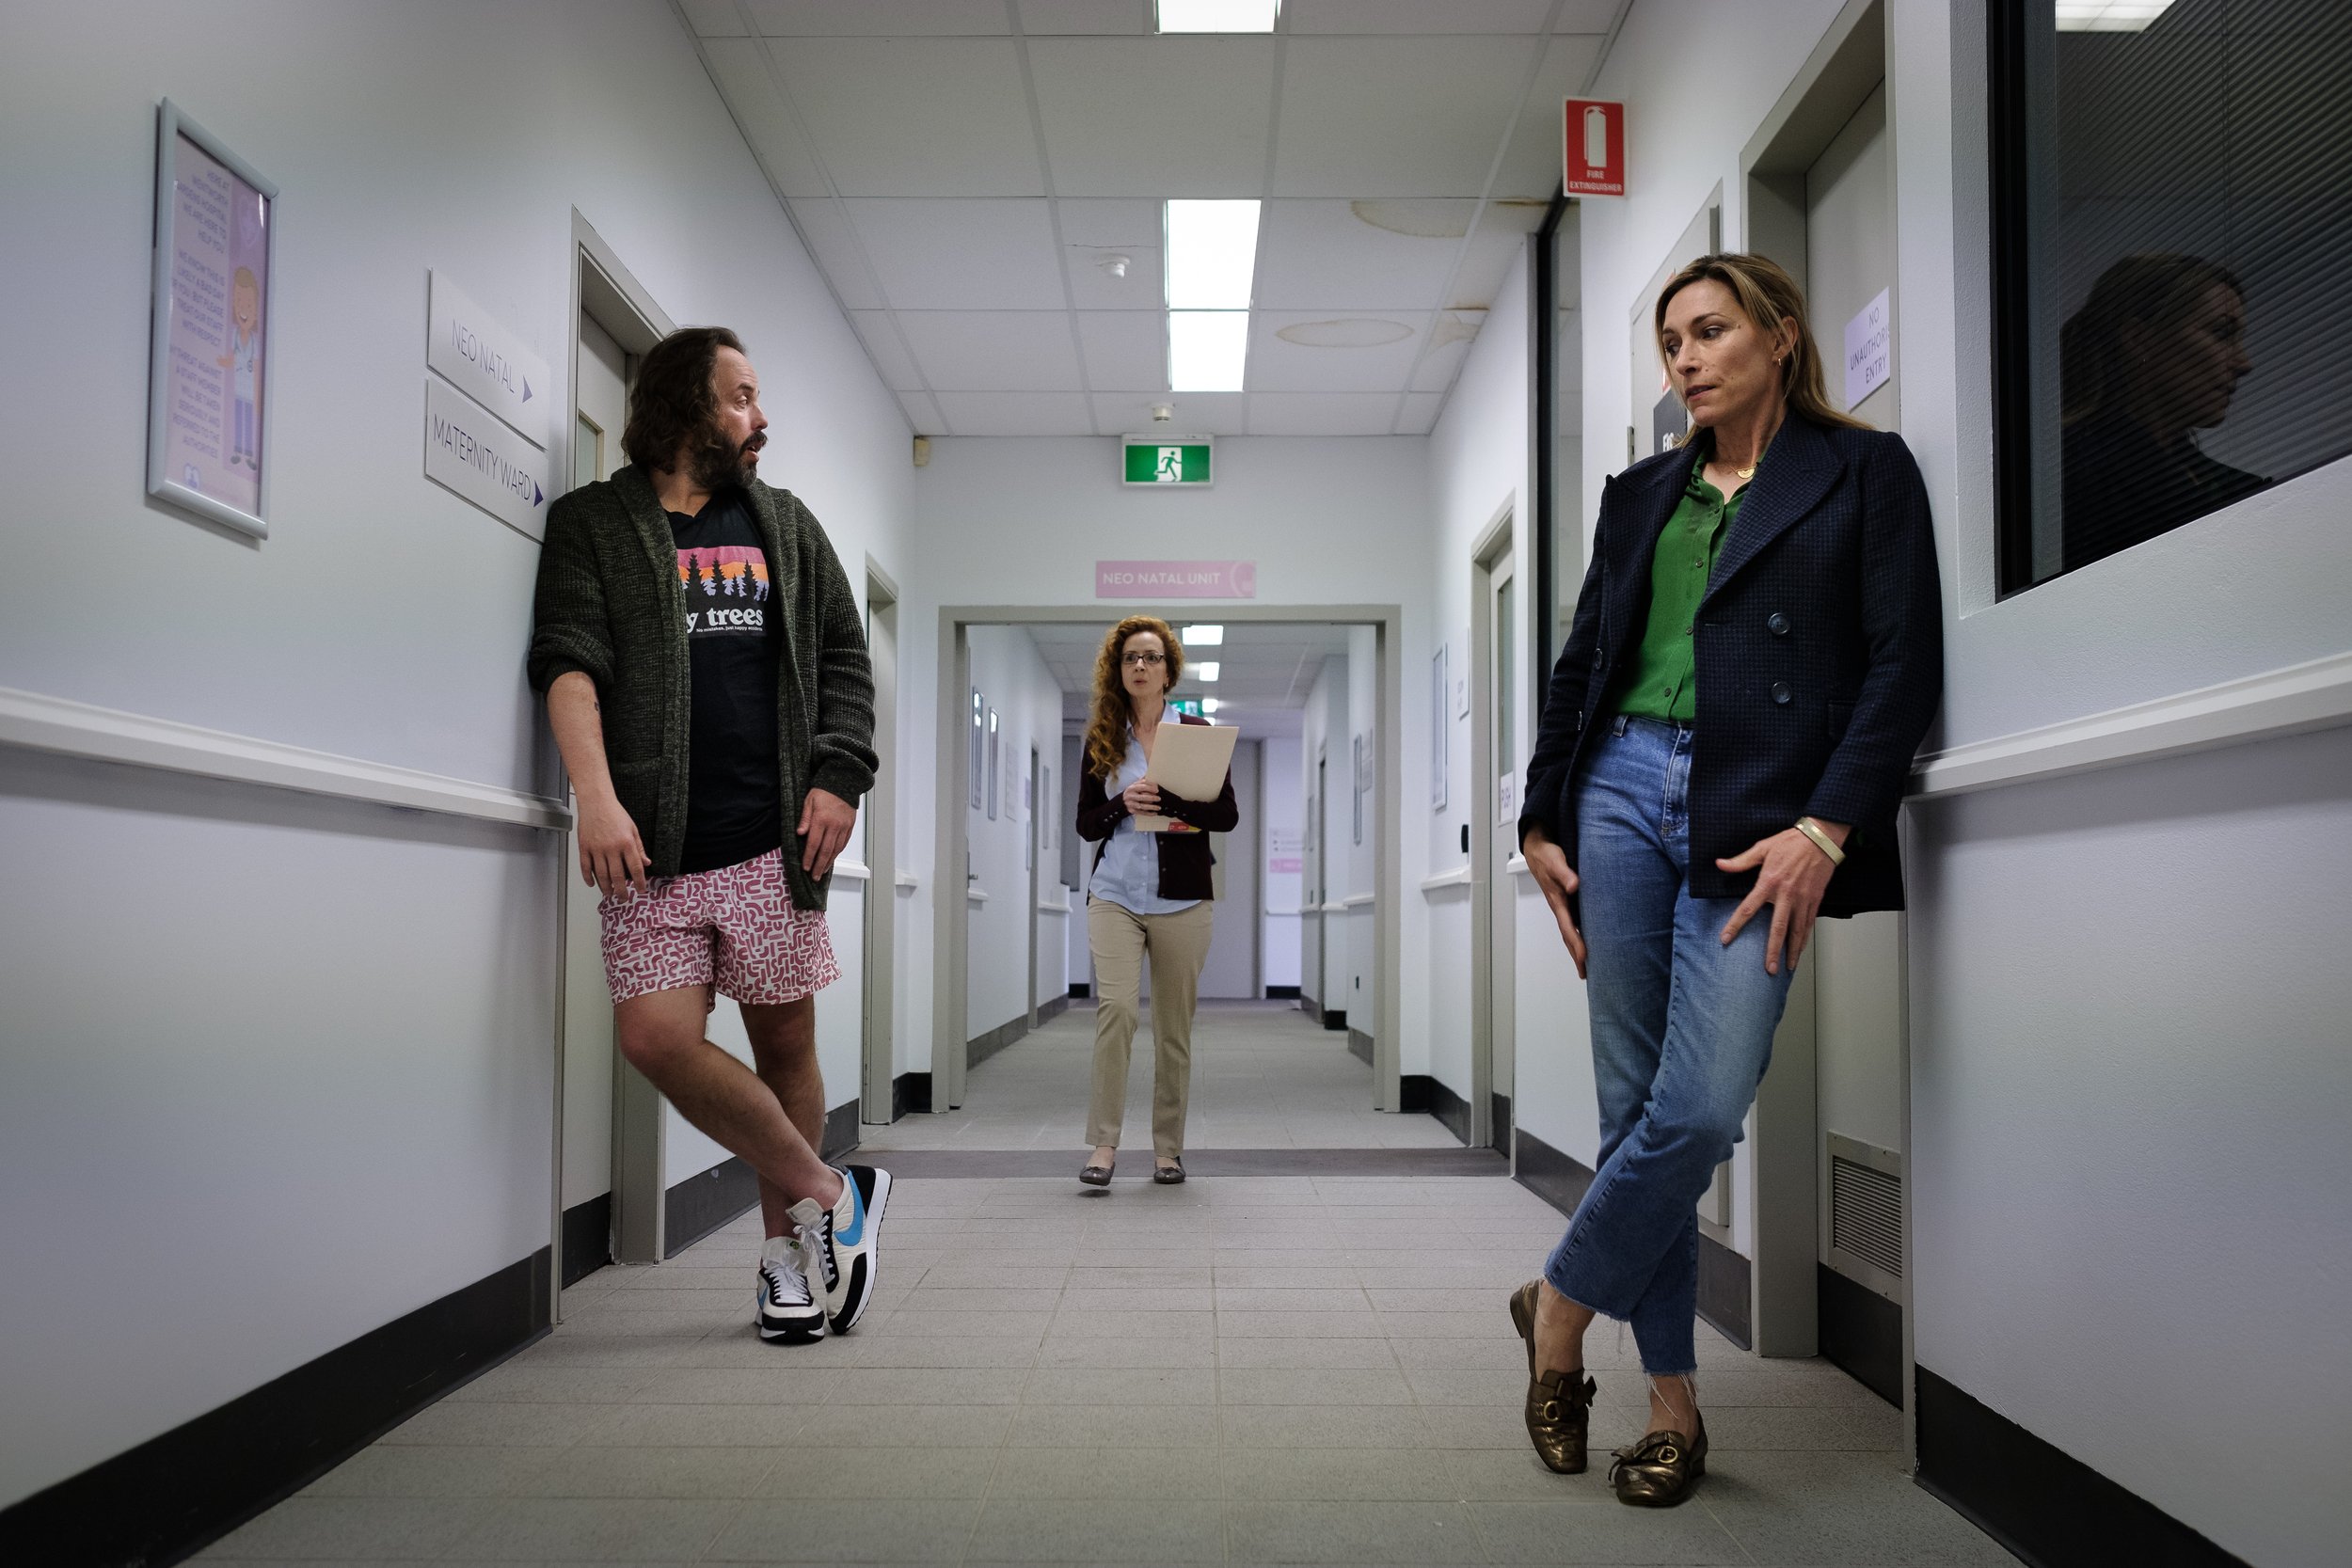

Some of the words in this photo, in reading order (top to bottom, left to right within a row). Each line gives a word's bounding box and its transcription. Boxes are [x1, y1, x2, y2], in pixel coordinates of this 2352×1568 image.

[1586, 169, 1605, 179] FIRE
[1569, 181, 1622, 192] EXTINGUISHER
[1868, 307, 1880, 329] NO
[452, 318, 477, 362] NEO
[480, 341, 515, 394] NATAL
[1866, 353, 1887, 384] ENTRY
[434, 413, 499, 481] MATERNITY
[501, 457, 532, 500] WARD
[1103, 572, 1135, 585] NEO
[1137, 572, 1184, 585] NATAL
[1187, 572, 1220, 585] UNIT
[707, 608, 763, 626] trees
